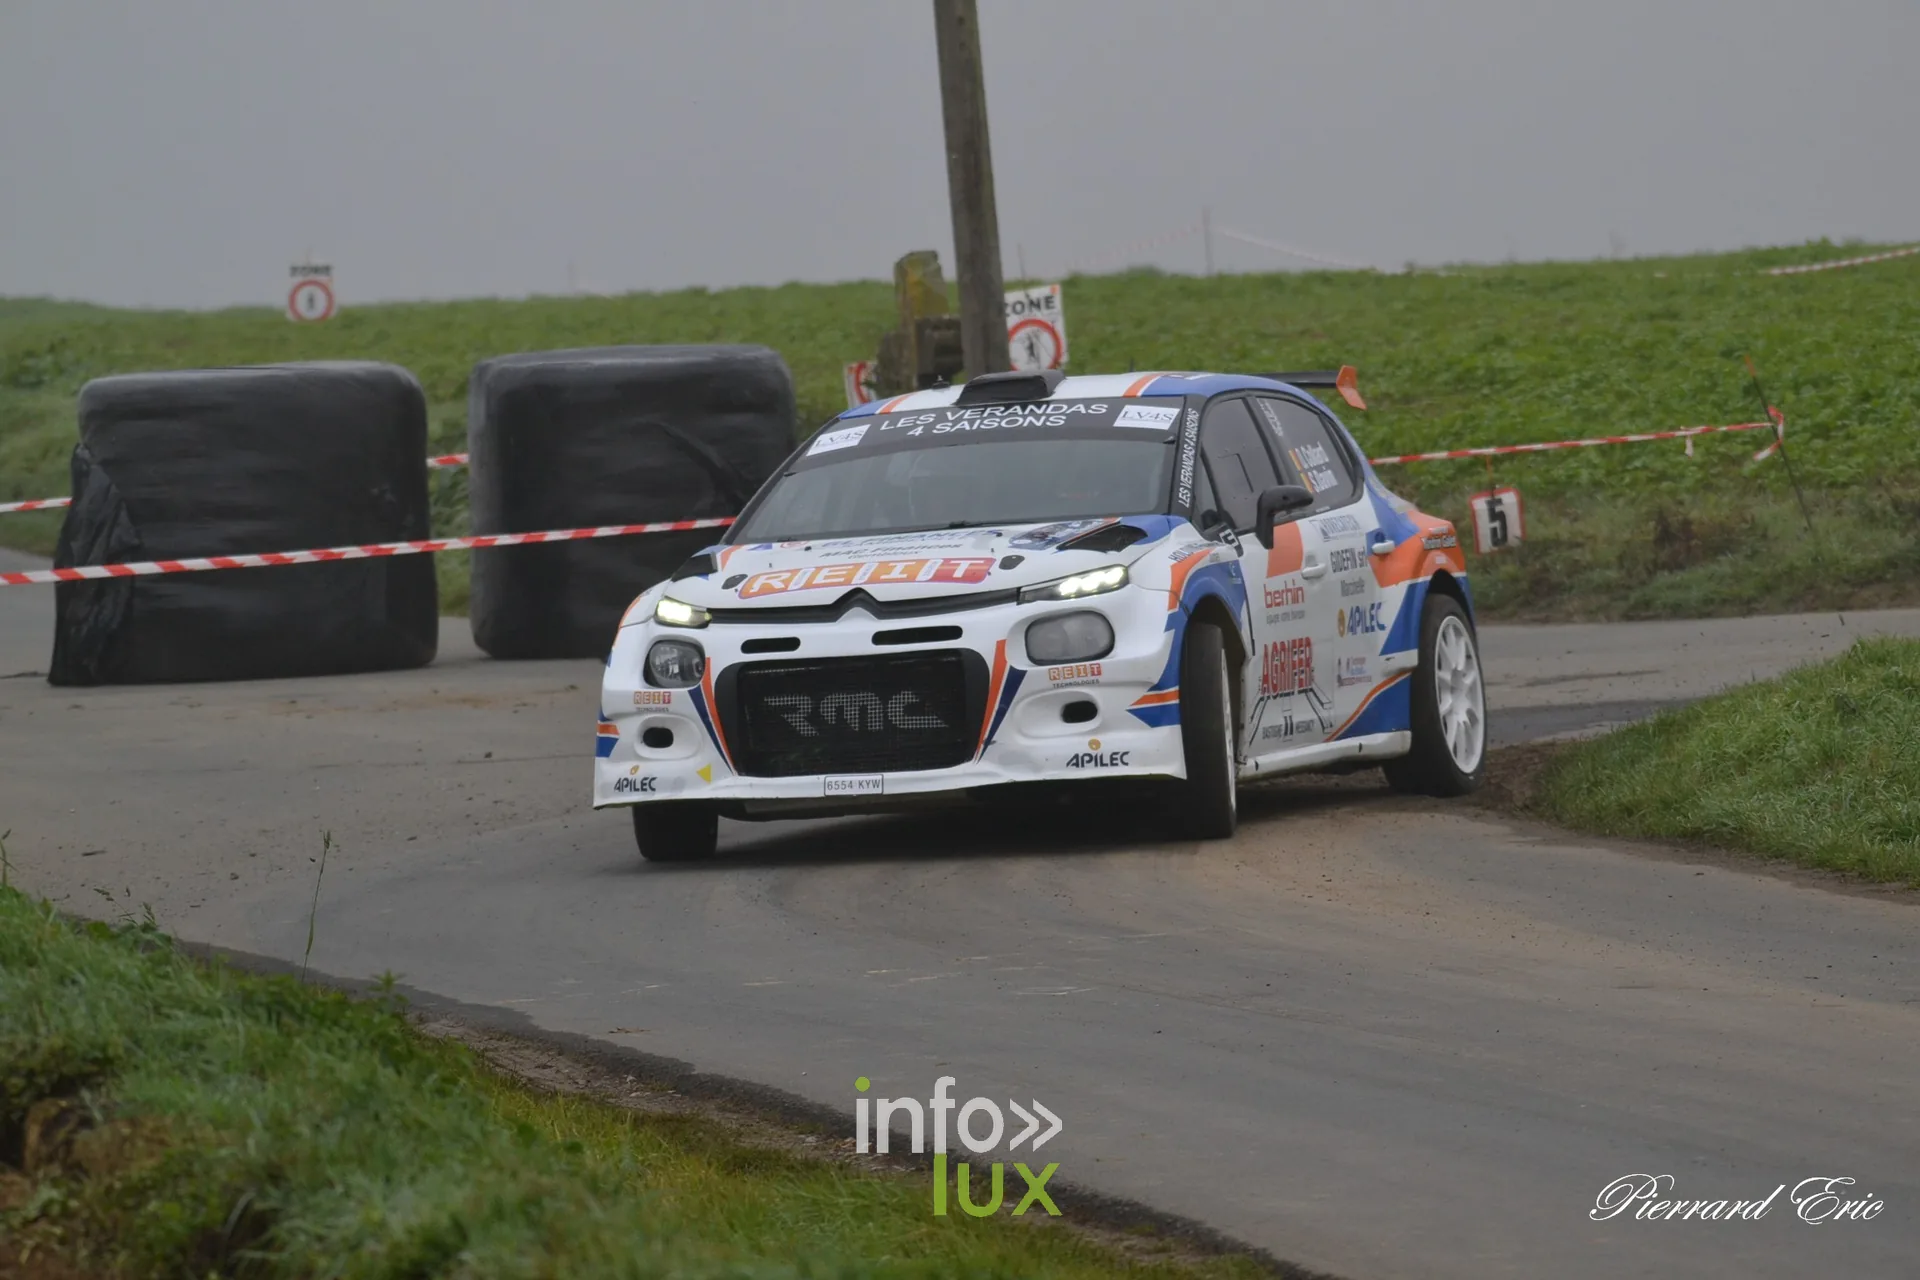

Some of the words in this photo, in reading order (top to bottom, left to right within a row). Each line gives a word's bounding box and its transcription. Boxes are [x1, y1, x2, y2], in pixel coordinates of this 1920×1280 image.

[880, 413, 936, 431] LES
[946, 403, 1108, 420] VERANDAS
[907, 425, 923, 437] 4
[932, 415, 1066, 434] SAISONS
[1185, 407, 1199, 441] SAISONS
[1180, 444, 1195, 489] VERANDAS
[1178, 488, 1190, 508] LES
[1484, 497, 1508, 547] 5
[748, 559, 985, 593] REIT
[1264, 578, 1304, 608] berhin
[1347, 601, 1387, 636] APILEC
[1048, 663, 1102, 681] REIT
[1261, 636, 1313, 696] AGRIFER
[1053, 679, 1100, 689] TECHNOLOGIES
[633, 691, 671, 704] REIT
[1066, 751, 1130, 768] APILEC
[614, 776, 657, 792] APILEC
[827, 780, 853, 791] 6554
[858, 779, 881, 790] KYW
